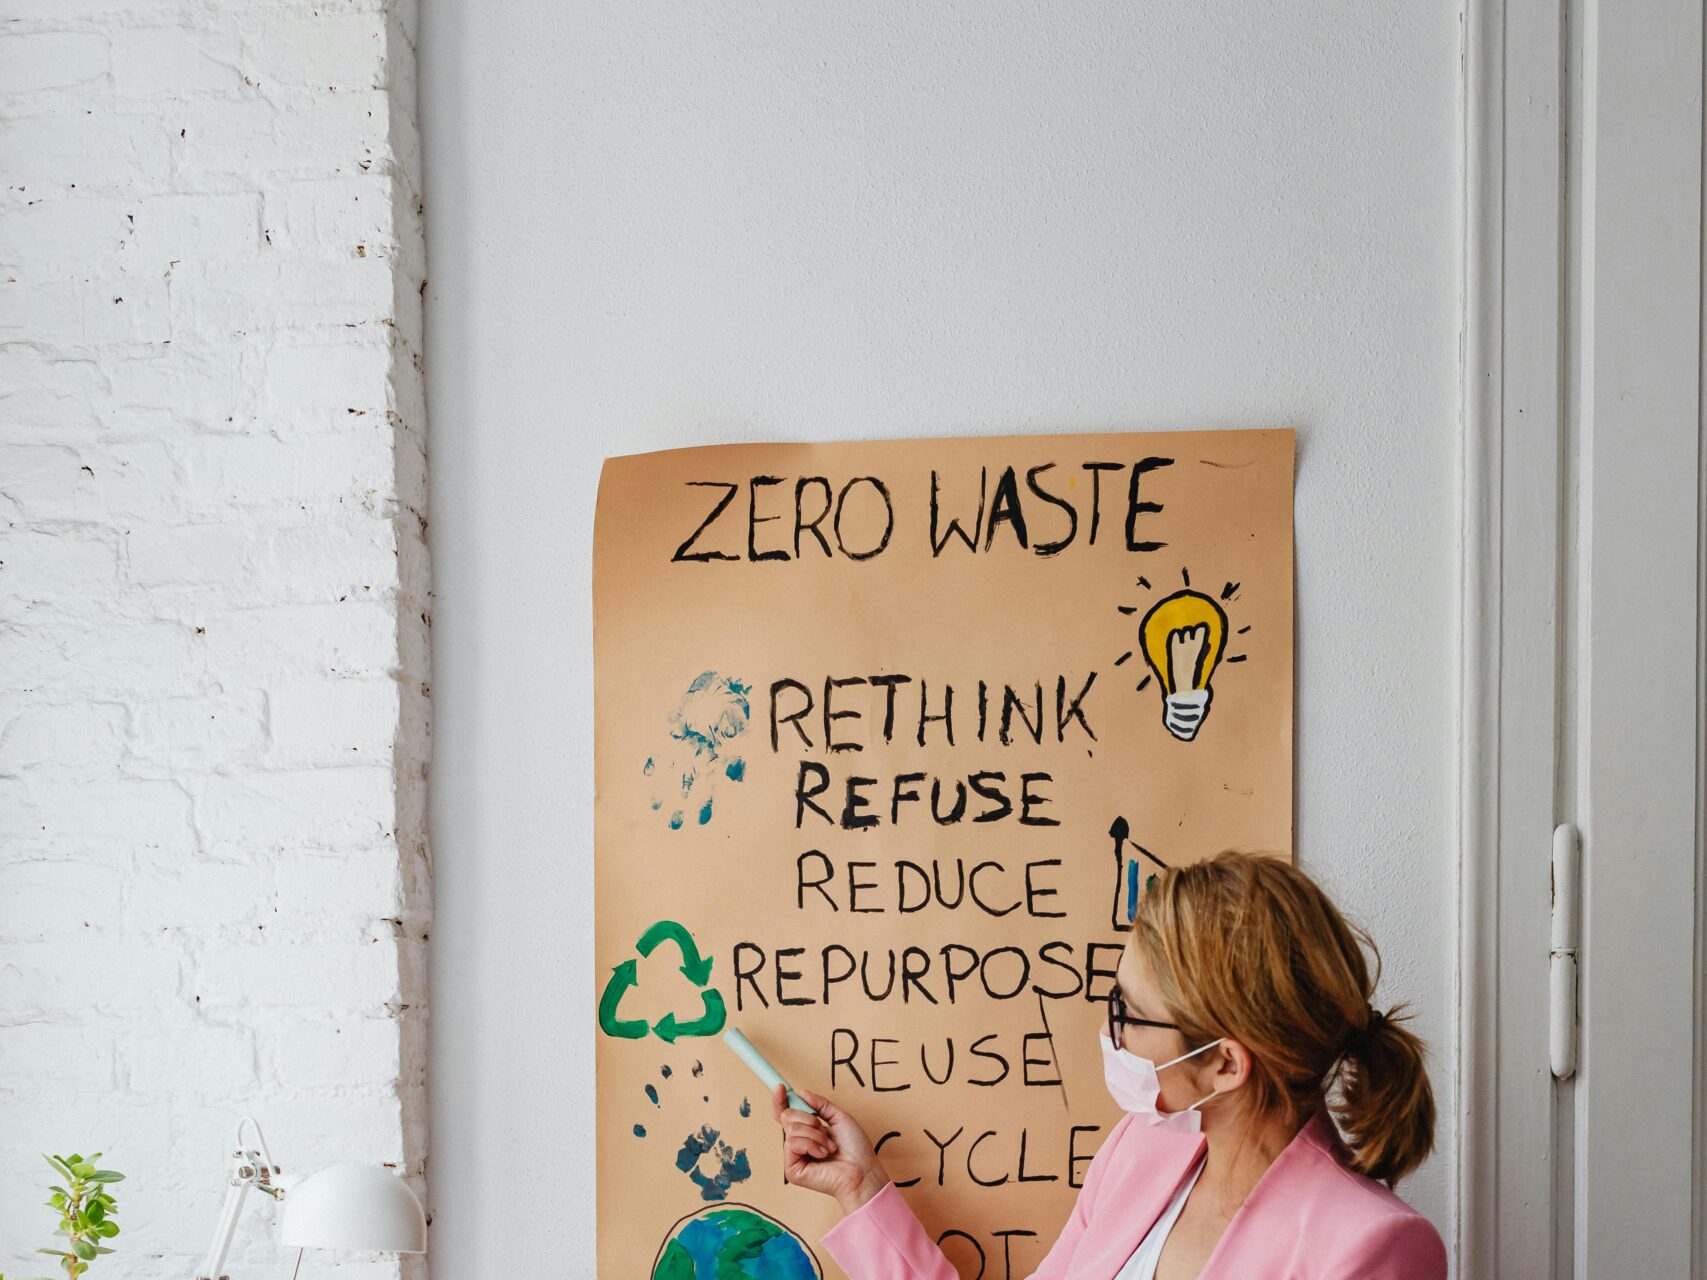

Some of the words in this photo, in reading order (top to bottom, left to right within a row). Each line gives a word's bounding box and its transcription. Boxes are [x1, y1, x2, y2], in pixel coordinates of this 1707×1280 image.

[671, 474, 895, 563] ZERO
[930, 457, 1175, 558] WASTE
[769, 671, 1098, 755] RETHINK
[795, 760, 1061, 832] REFUSE
[796, 849, 1067, 917] REDUCE
[733, 940, 1126, 1012] REPURPOSE
[831, 1028, 1063, 1093] REUSE
[782, 1125, 1101, 1189] CYCLE
